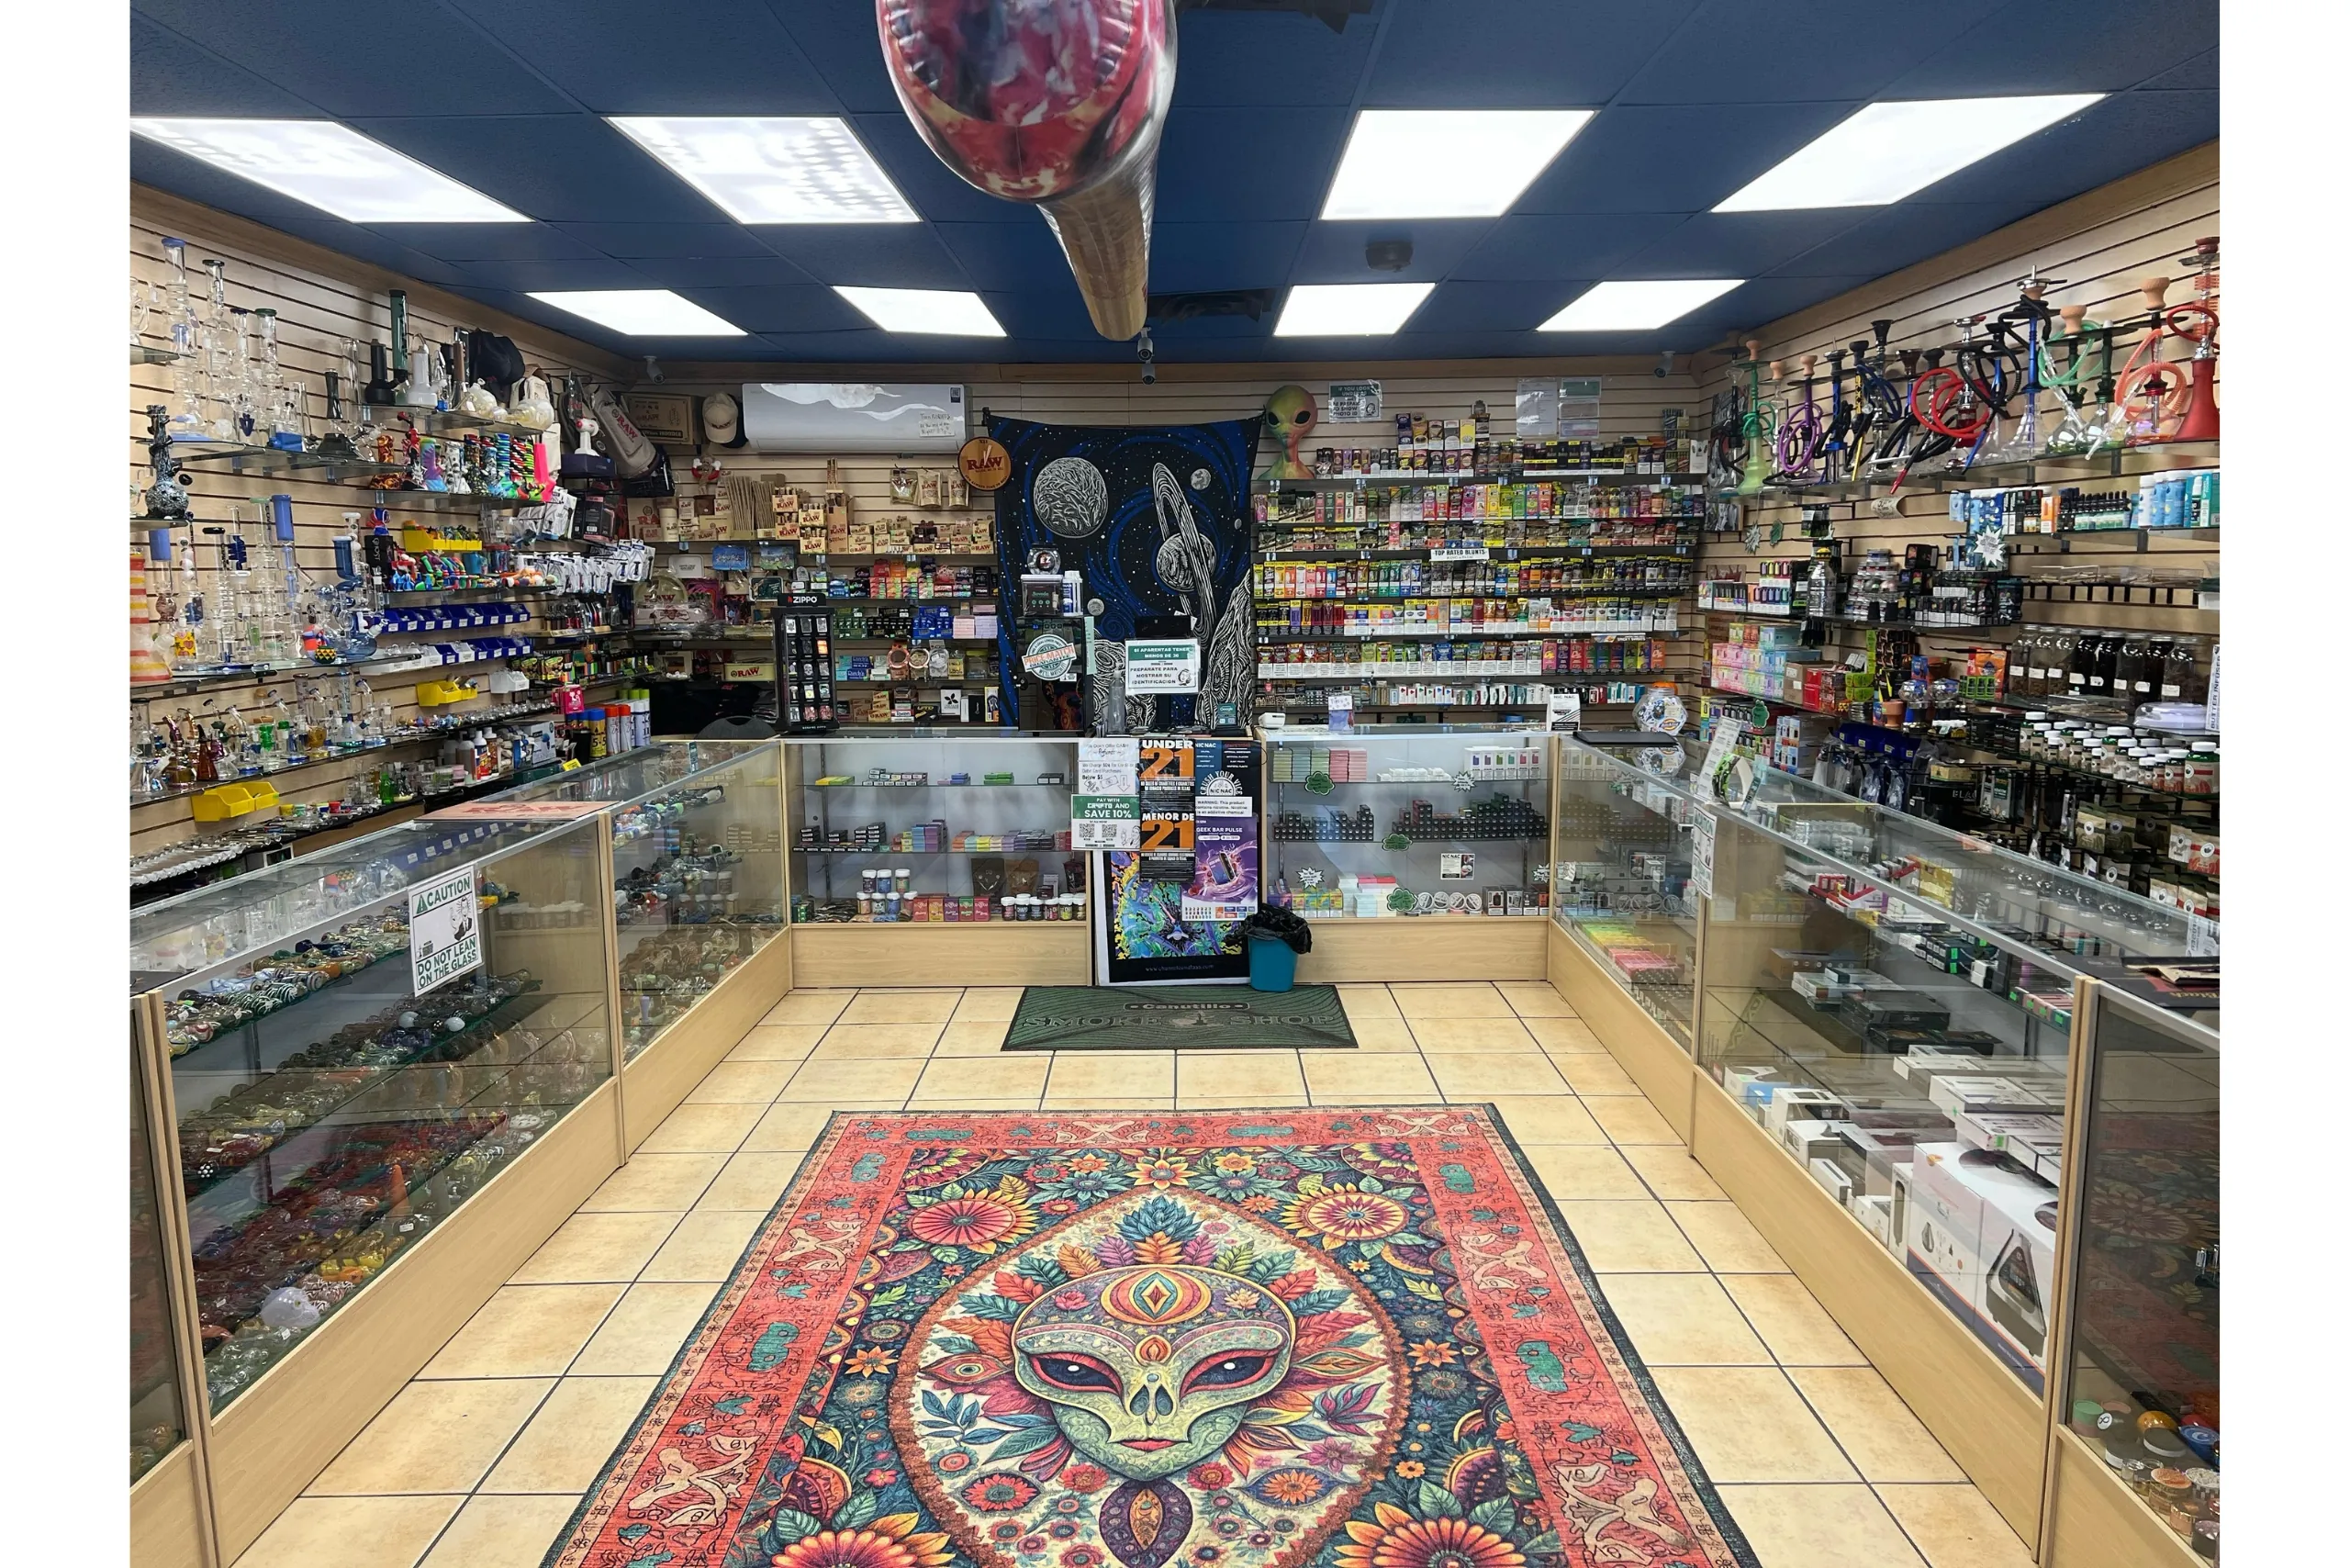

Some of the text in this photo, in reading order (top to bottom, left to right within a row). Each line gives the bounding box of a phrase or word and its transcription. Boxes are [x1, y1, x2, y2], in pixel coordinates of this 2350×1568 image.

[616, 414, 639, 440] RAW
[967, 457, 1003, 471] RAW
[716, 504, 731, 512] RAW
[802, 514, 820, 523] RAW
[716, 525, 727, 533] AW
[804, 543, 822, 551] RAW
[1040, 556, 1051, 565] EZ
[793, 596, 818, 604] ZIPPO
[738, 666, 760, 678] RAW
[1142, 740, 1194, 749] UNDER
[1140, 748, 1194, 780] 21
[1200, 770, 1243, 795] CRUSH YOUR VICE
[1084, 810, 1132, 818] SAVE 10%
[1142, 821, 1194, 851] 21
[427, 876, 471, 908] CAUTION
[417, 936, 476, 977] DO NOT LEAN
[419, 949, 477, 988] ON THE GLASS
[1023, 1015, 1336, 1027] SMOKE SHOP
